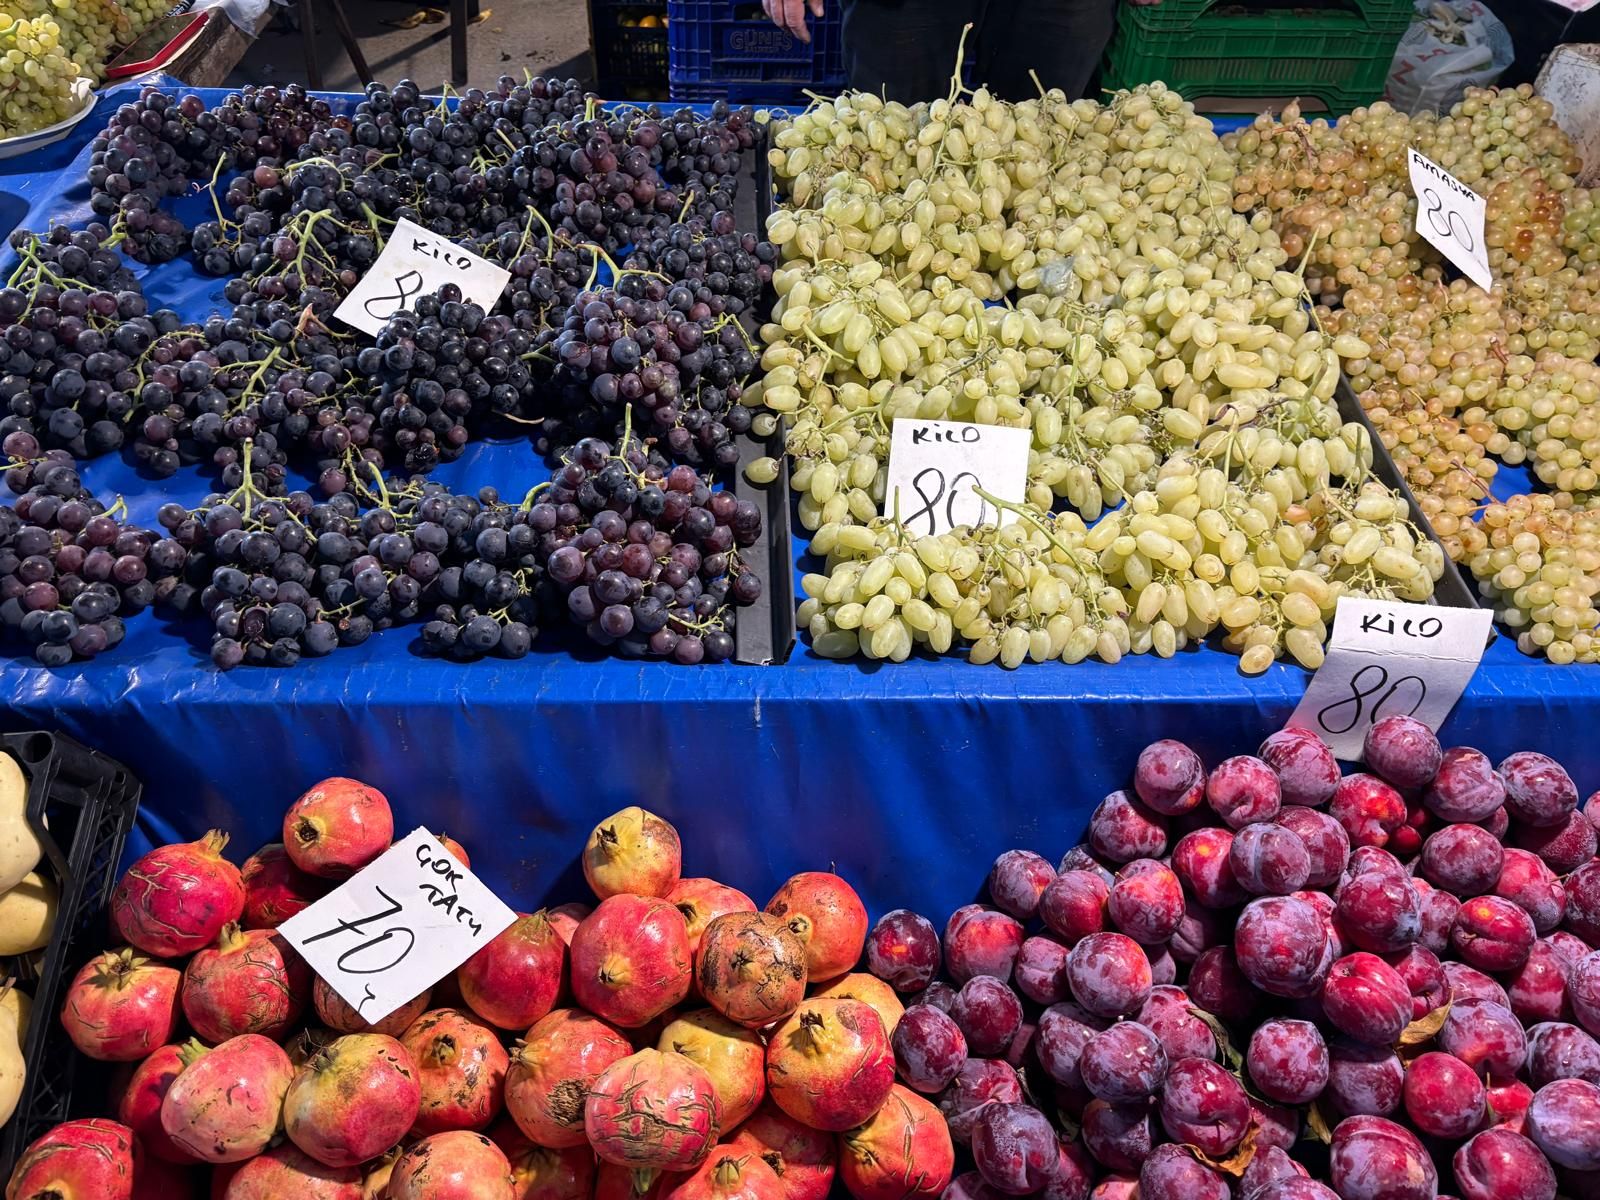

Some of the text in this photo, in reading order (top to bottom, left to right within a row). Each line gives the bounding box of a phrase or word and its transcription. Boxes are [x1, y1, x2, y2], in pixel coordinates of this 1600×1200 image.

[1423, 187, 1474, 252] 80
[363, 270, 424, 320] 8
[903, 467, 986, 536] 80
[1317, 664, 1427, 734] 80
[302, 885, 415, 974] 70
